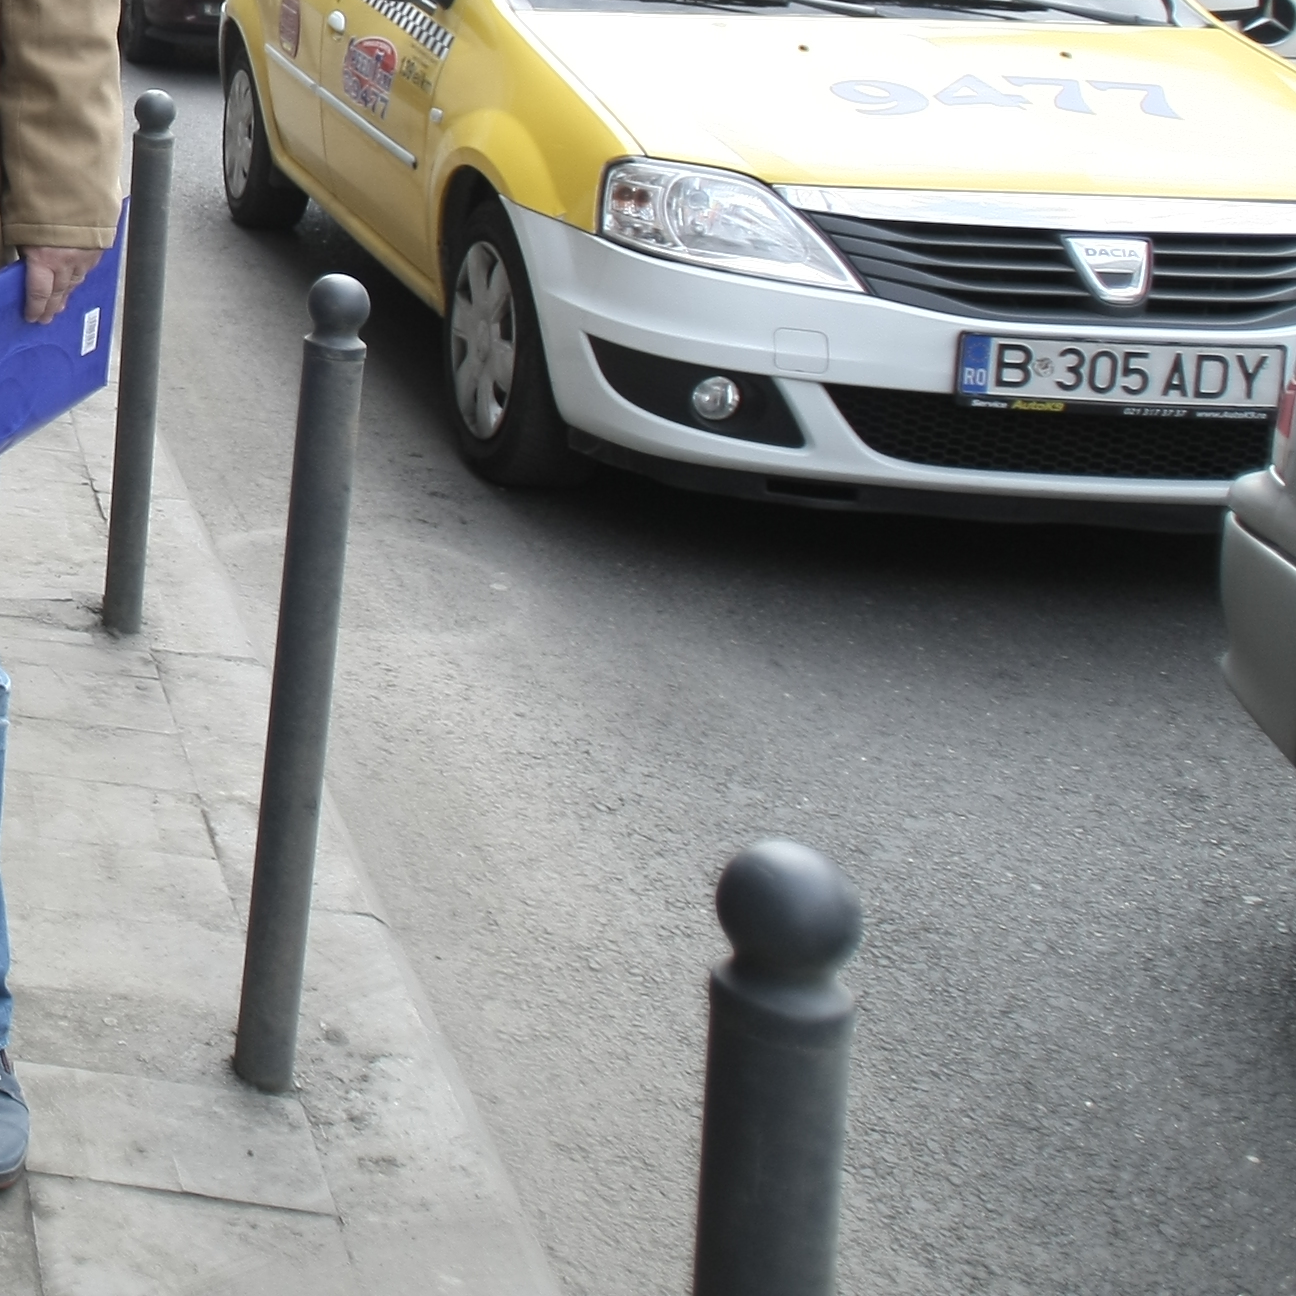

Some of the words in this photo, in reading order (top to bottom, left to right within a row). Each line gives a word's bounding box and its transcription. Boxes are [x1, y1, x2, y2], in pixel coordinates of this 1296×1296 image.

[829, 74, 1185, 120] 9477
[1084, 247, 1140, 258] DACIA
[964, 367, 987, 386] RO
[995, 342, 1034, 388] B
[1054, 346, 1151, 396] 305
[1161, 352, 1270, 400] ADY
[971, 399, 1008, 408] Service
